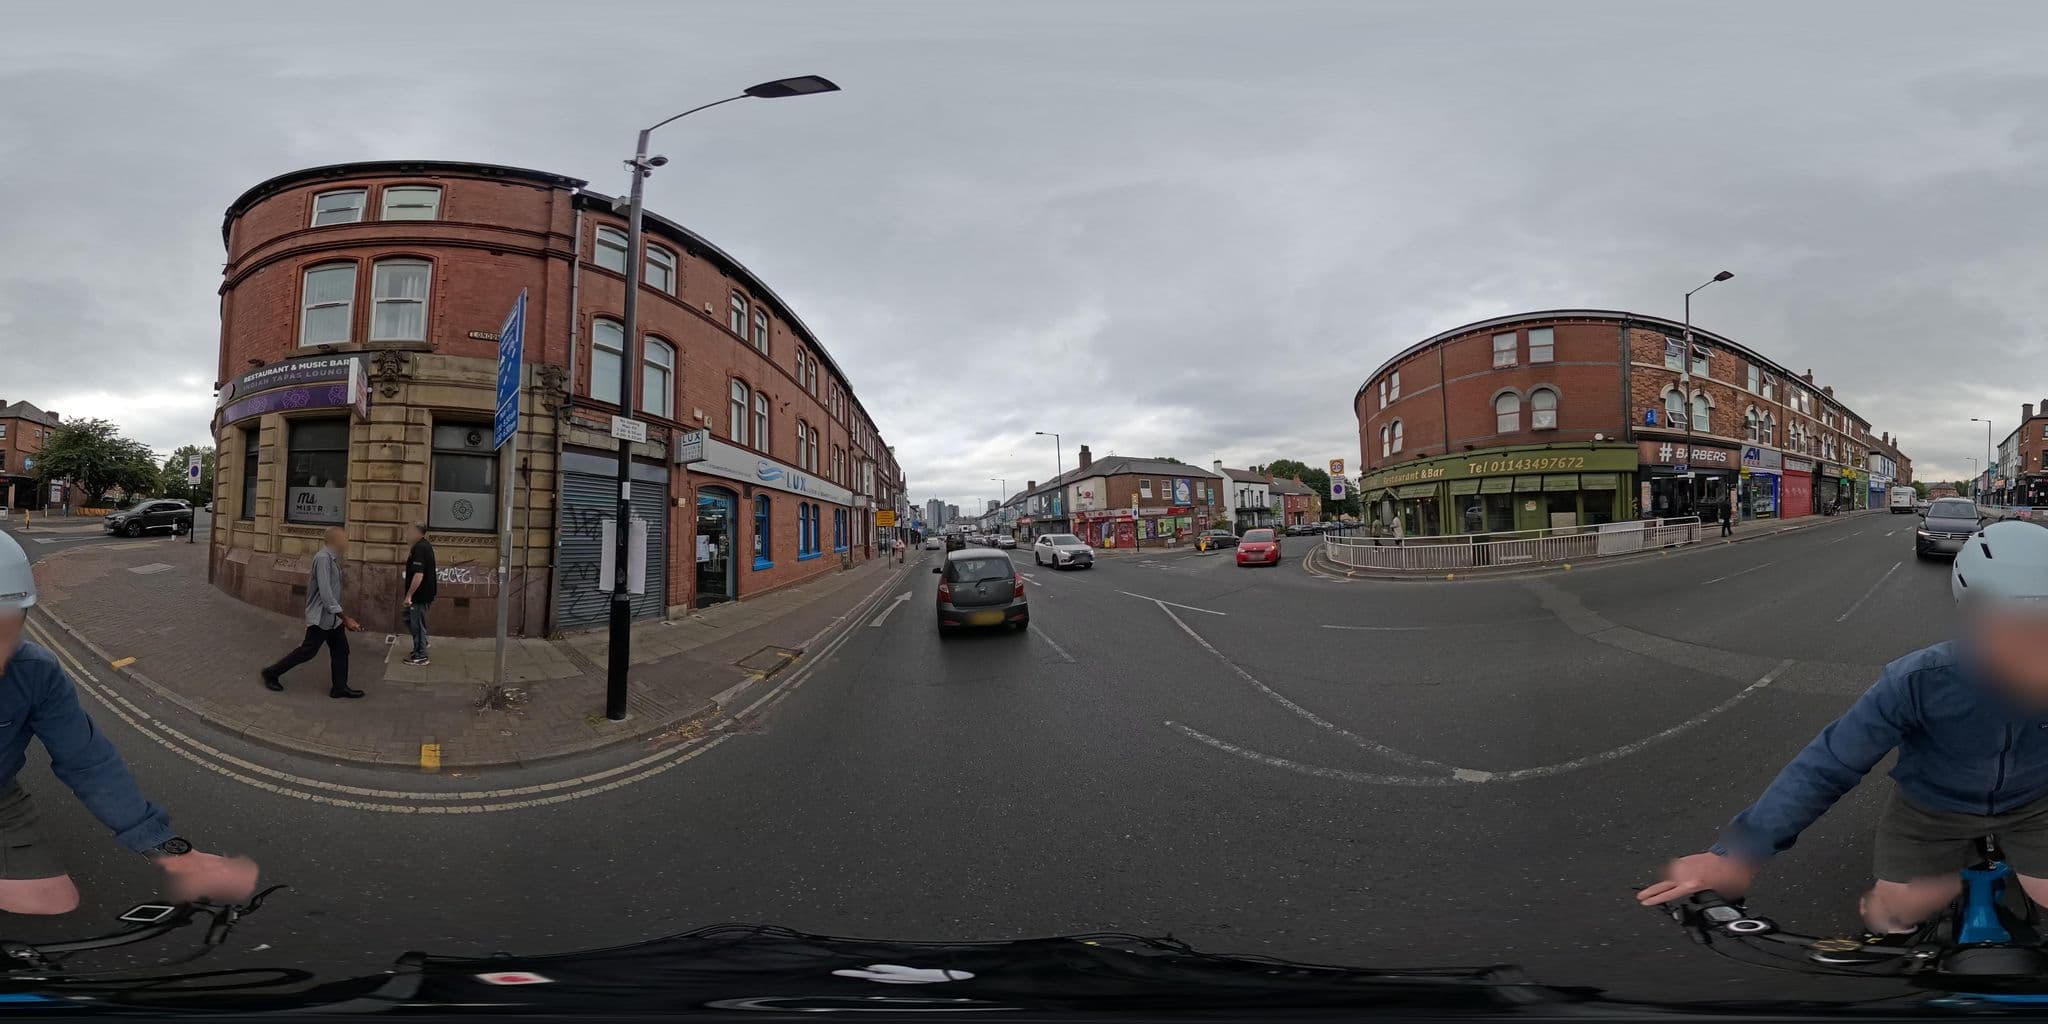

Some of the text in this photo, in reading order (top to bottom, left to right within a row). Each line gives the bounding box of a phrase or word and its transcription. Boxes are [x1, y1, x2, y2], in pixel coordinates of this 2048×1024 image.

[243, 365, 288, 383] RESTAURANT
[298, 360, 328, 370] MUSIC
[330, 359, 350, 367] BAR
[243, 379, 269, 391] INDIAN
[272, 373, 302, 383] TAPAS
[682, 431, 701, 444] LUX
[1469, 456, 1585, 474] Tel 01143497672
[786, 471, 806, 492] LUX
[1383, 470, 1419, 485] Restaurant
[1421, 467, 1445, 479] &Bar
